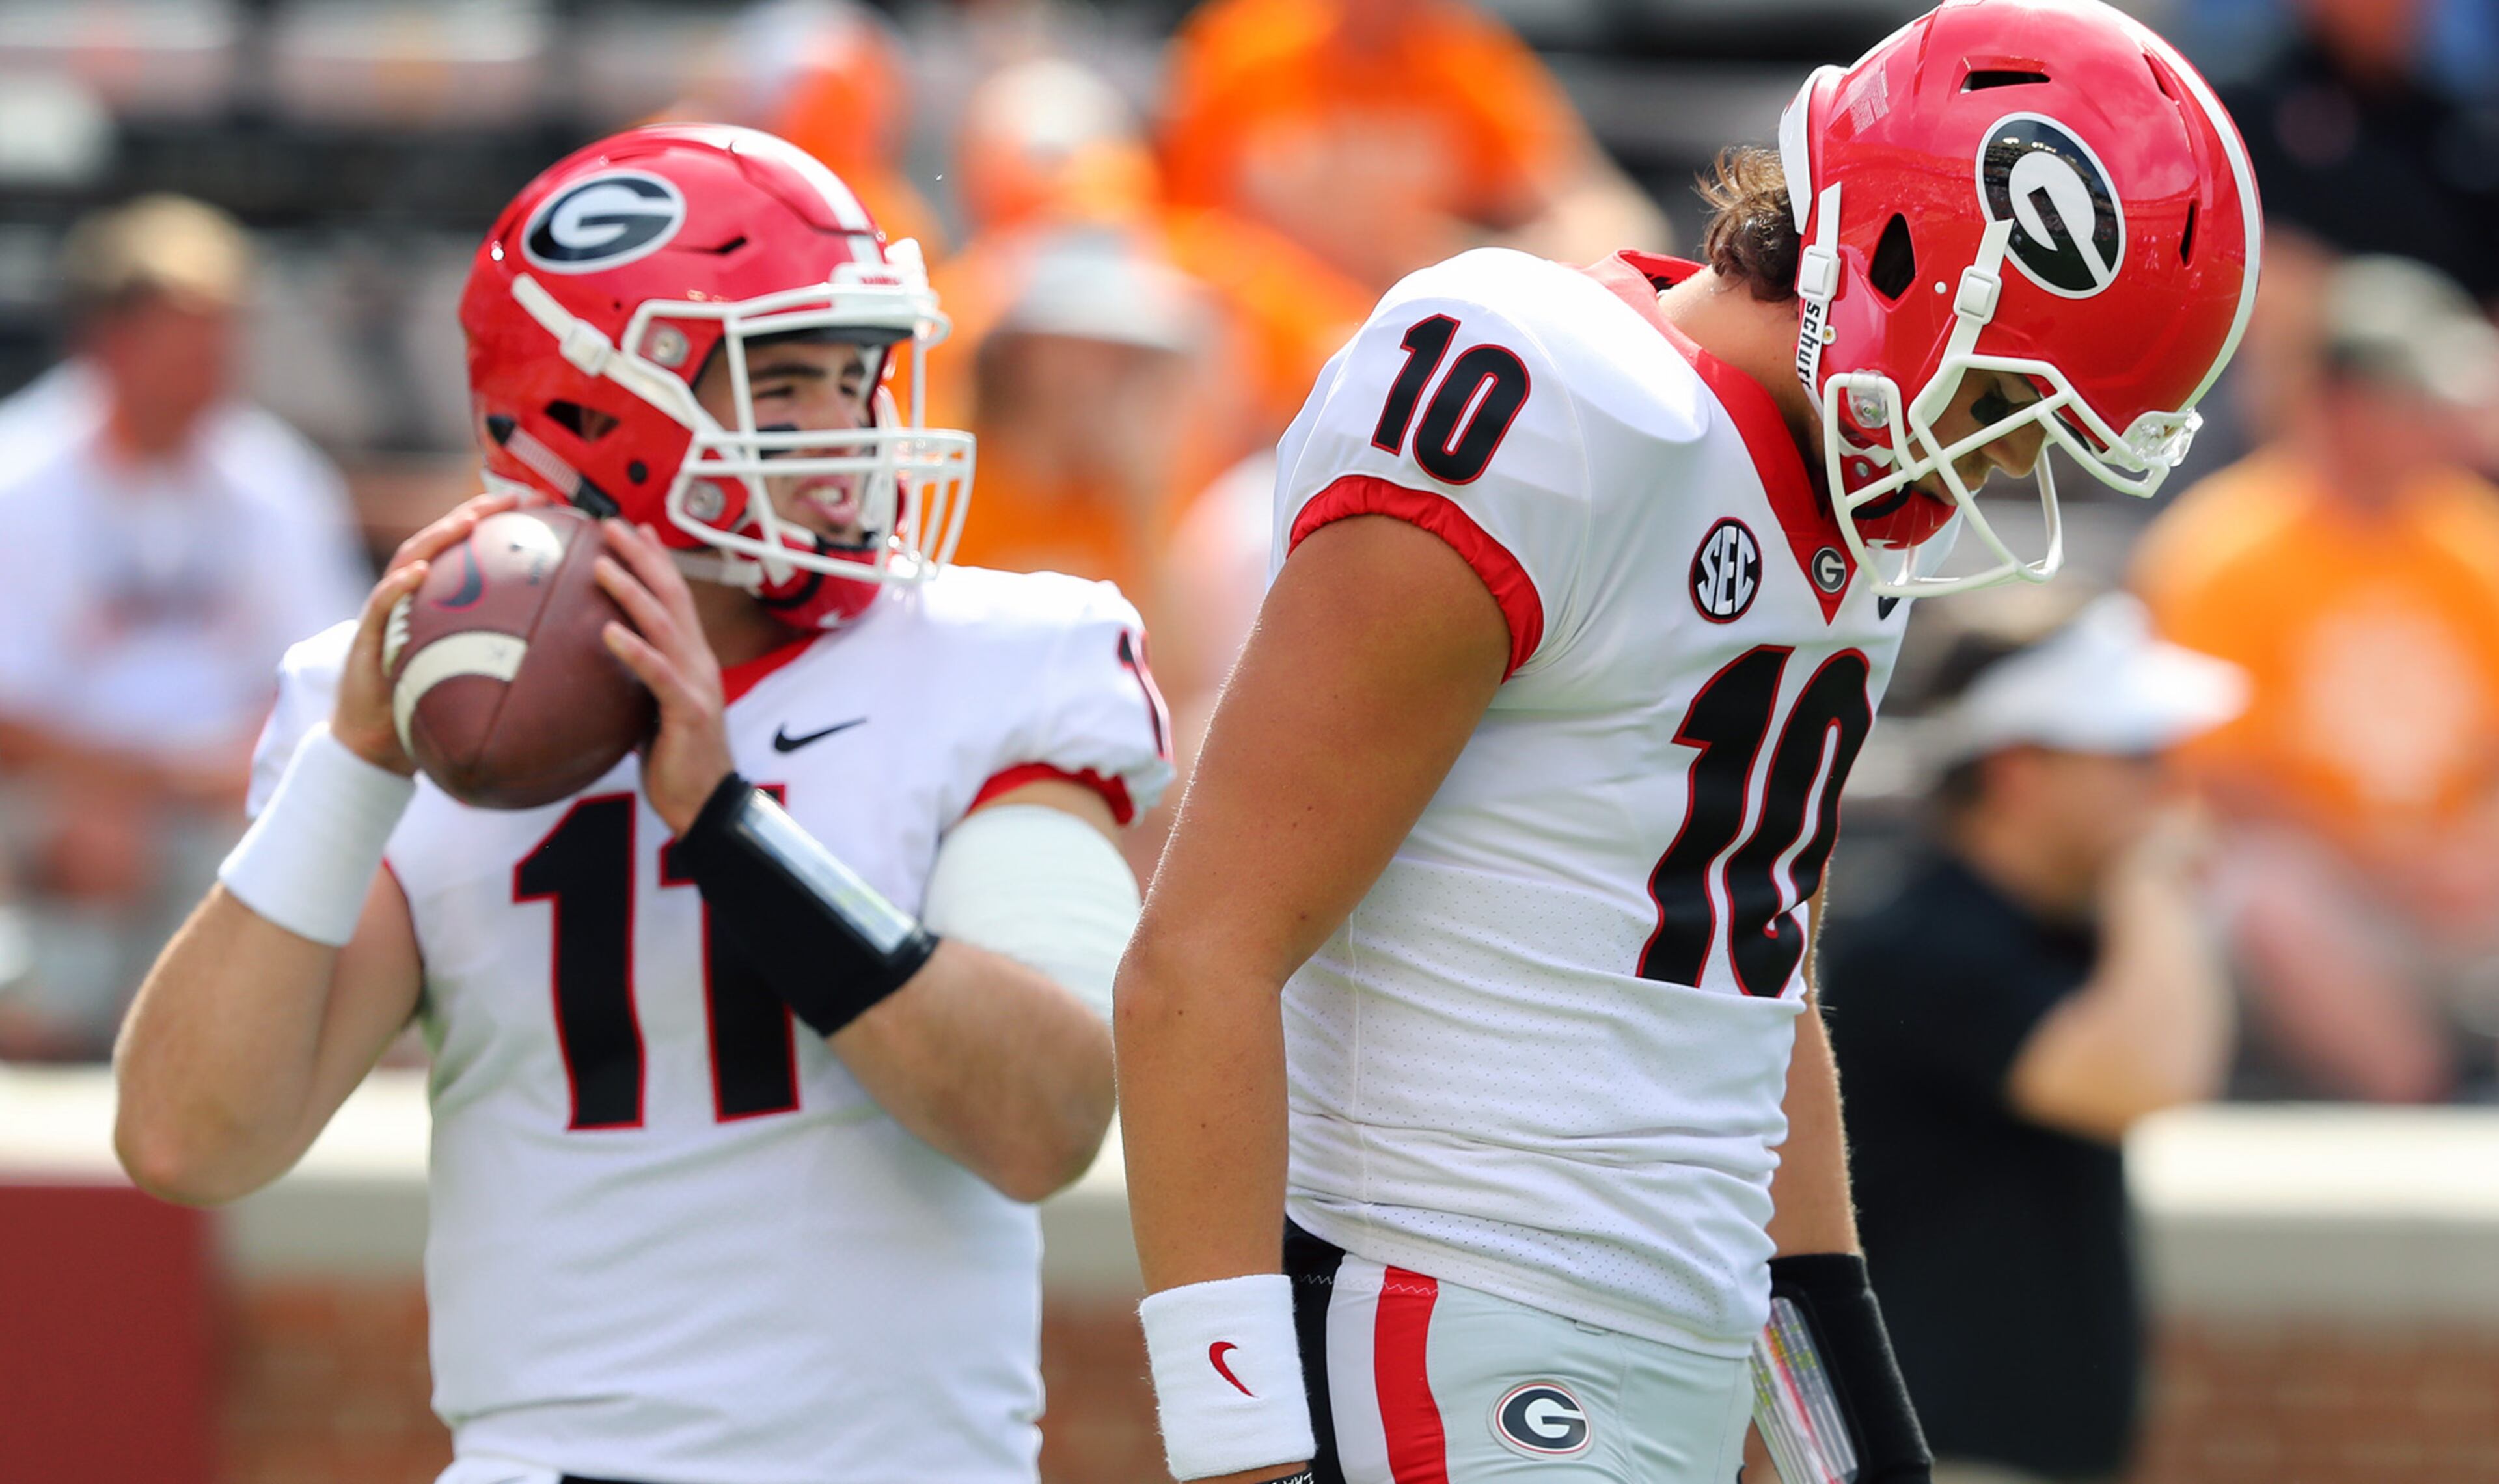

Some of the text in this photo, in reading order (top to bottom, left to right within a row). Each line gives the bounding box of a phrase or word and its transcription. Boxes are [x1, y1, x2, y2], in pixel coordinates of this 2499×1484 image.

[526, 176, 677, 263] G
[1371, 313, 1531, 485] 10
[1696, 524, 1756, 615] SEC
[1812, 547, 1847, 593] G
[1635, 644, 1872, 999] 10
[1501, 1388, 1587, 1450] G
